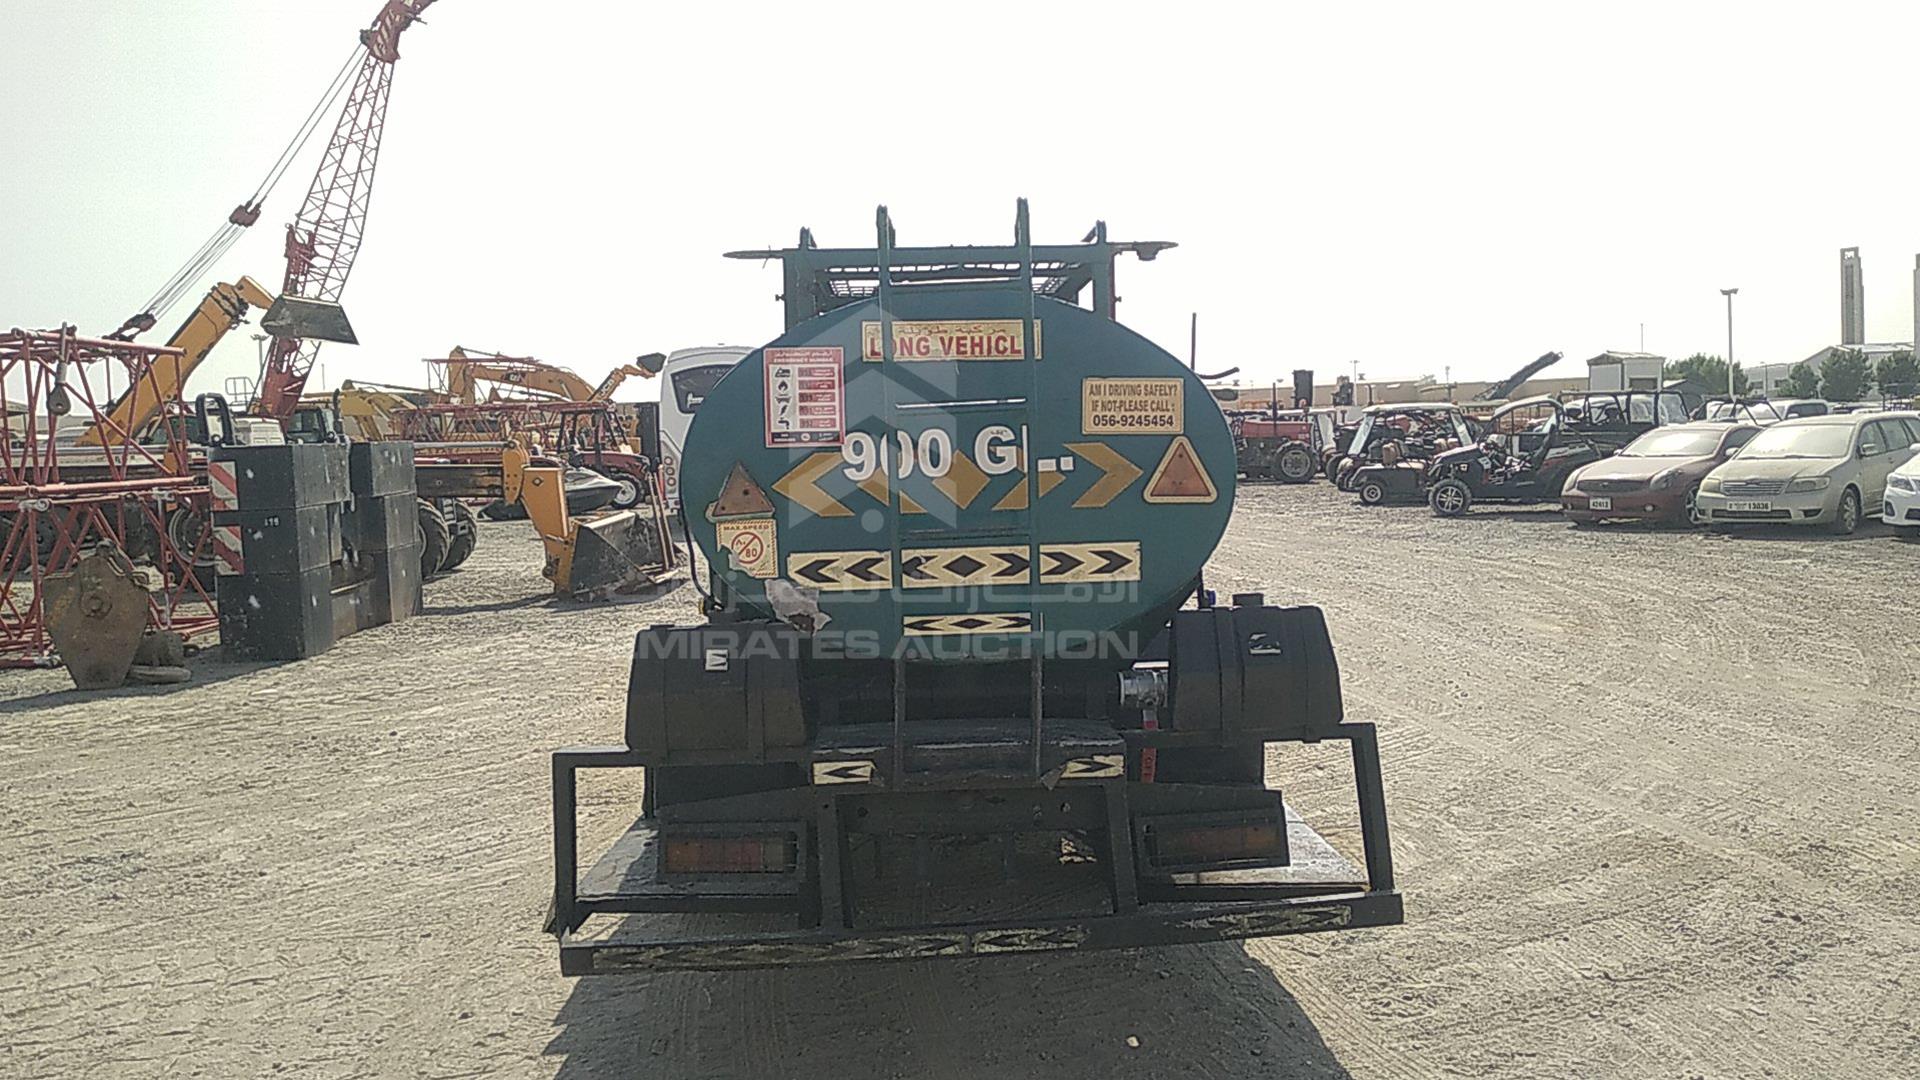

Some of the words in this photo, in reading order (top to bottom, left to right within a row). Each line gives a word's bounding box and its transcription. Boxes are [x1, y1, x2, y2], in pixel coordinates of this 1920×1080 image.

[870, 336, 931, 357] LNG
[939, 335, 1023, 357] VEHICL
[1089, 384, 1101, 396] AM
[1108, 384, 1142, 396] DRIVING
[1143, 384, 1178, 396] SAFELY?
[1092, 400, 1099, 412] IF
[1093, 415, 1174, 427] 056-9245454
[841, 428, 952, 481] 900
[745, 548, 758, 558] 80
